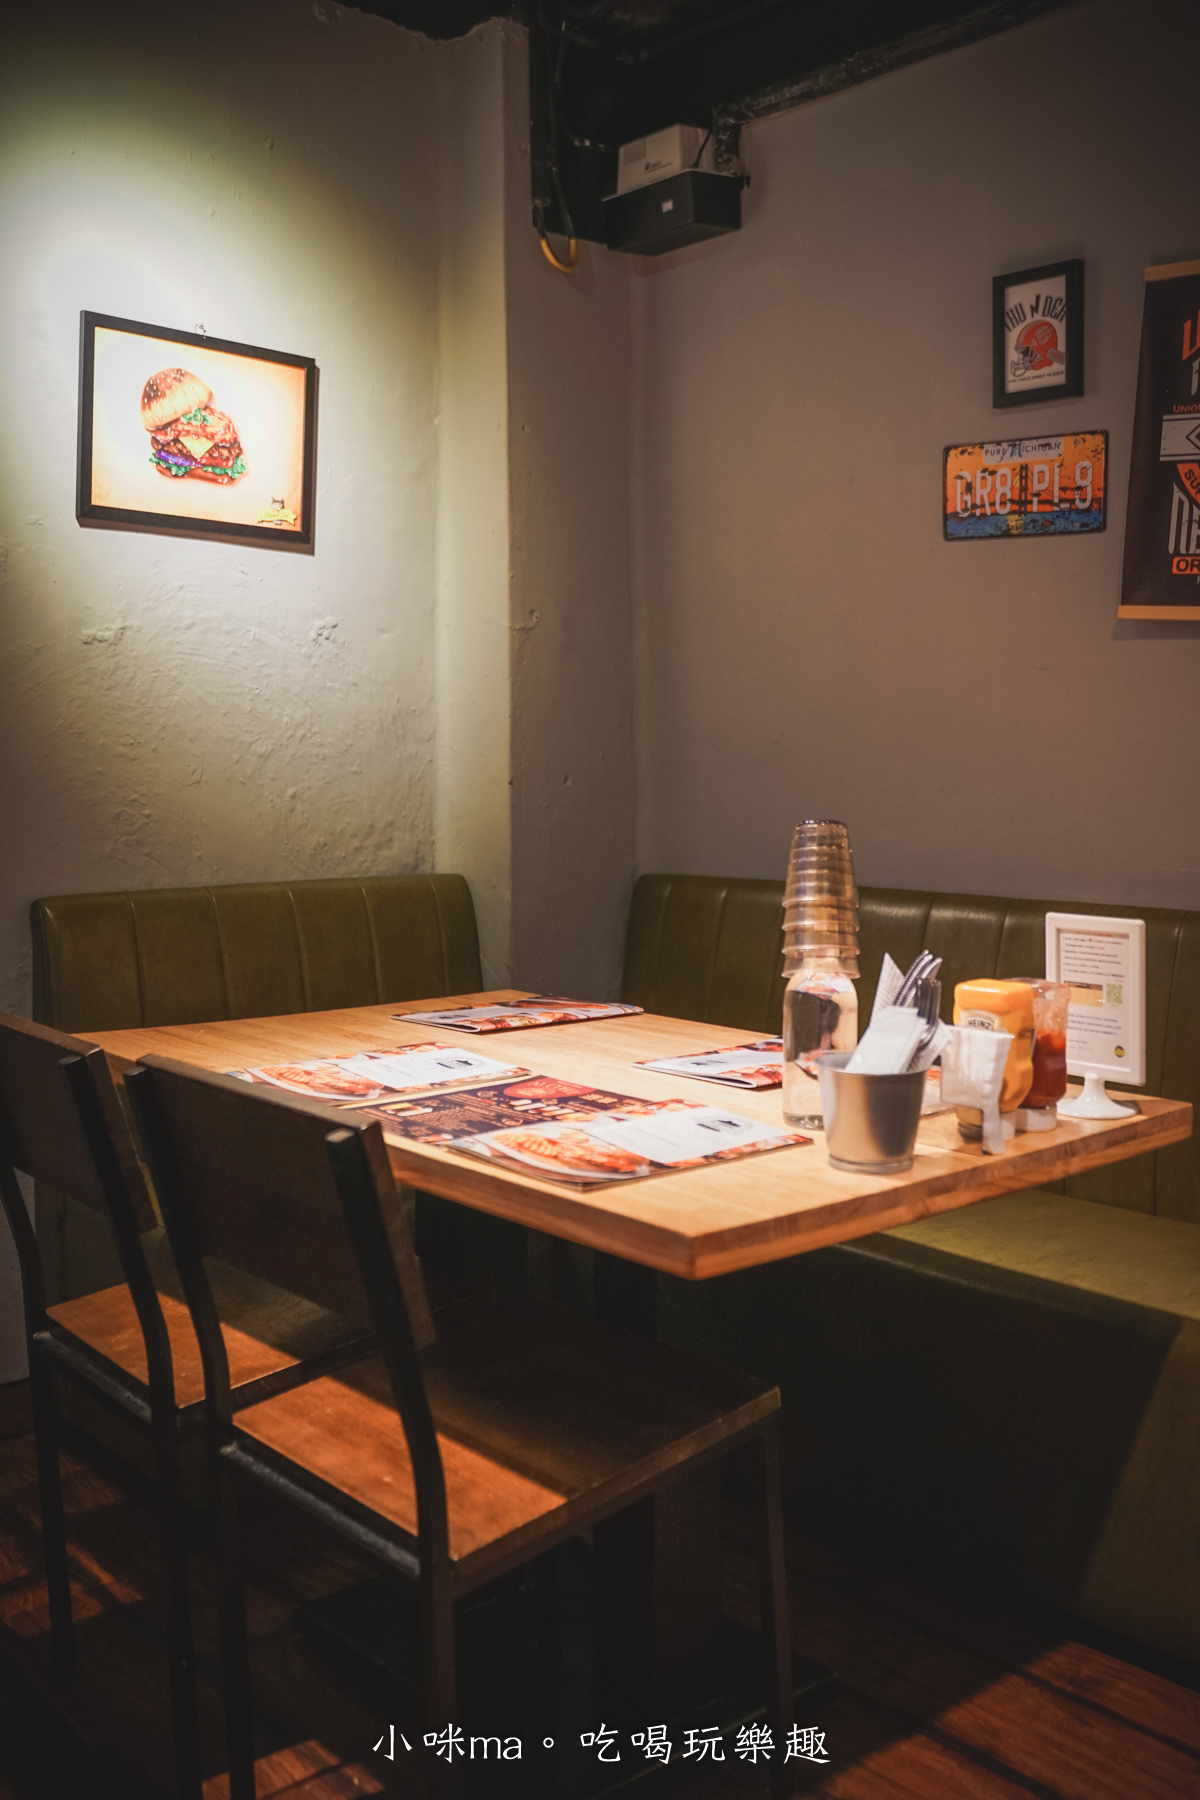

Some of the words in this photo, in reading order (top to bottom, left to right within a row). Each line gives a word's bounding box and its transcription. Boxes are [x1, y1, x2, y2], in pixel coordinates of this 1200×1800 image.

[955, 467, 1012, 517] GR8
[1032, 461, 1093, 512] PL8
[967, 1015, 992, 1031] HEINZ
